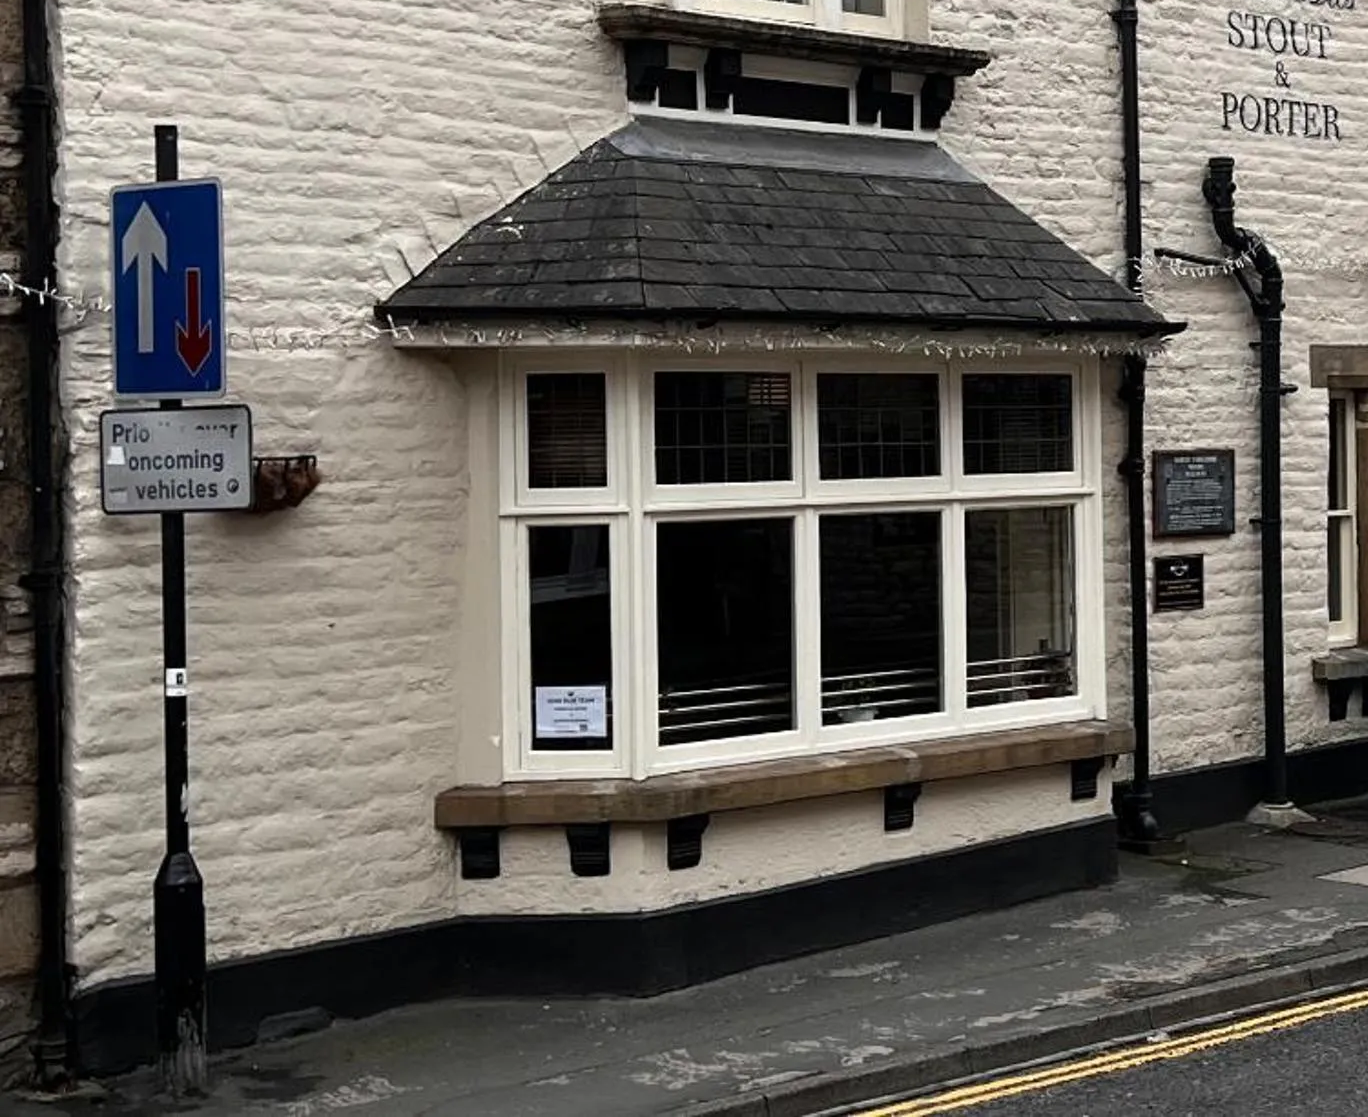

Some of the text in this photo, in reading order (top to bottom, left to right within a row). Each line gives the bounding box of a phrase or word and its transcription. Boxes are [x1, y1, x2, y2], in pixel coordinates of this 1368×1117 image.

[1228, 10, 1330, 59] STOUT
[1274, 61, 1291, 89] &
[1221, 92, 1342, 141] PORTER
[128, 449, 224, 472] oncoming
[136, 478, 218, 500] vehicles
